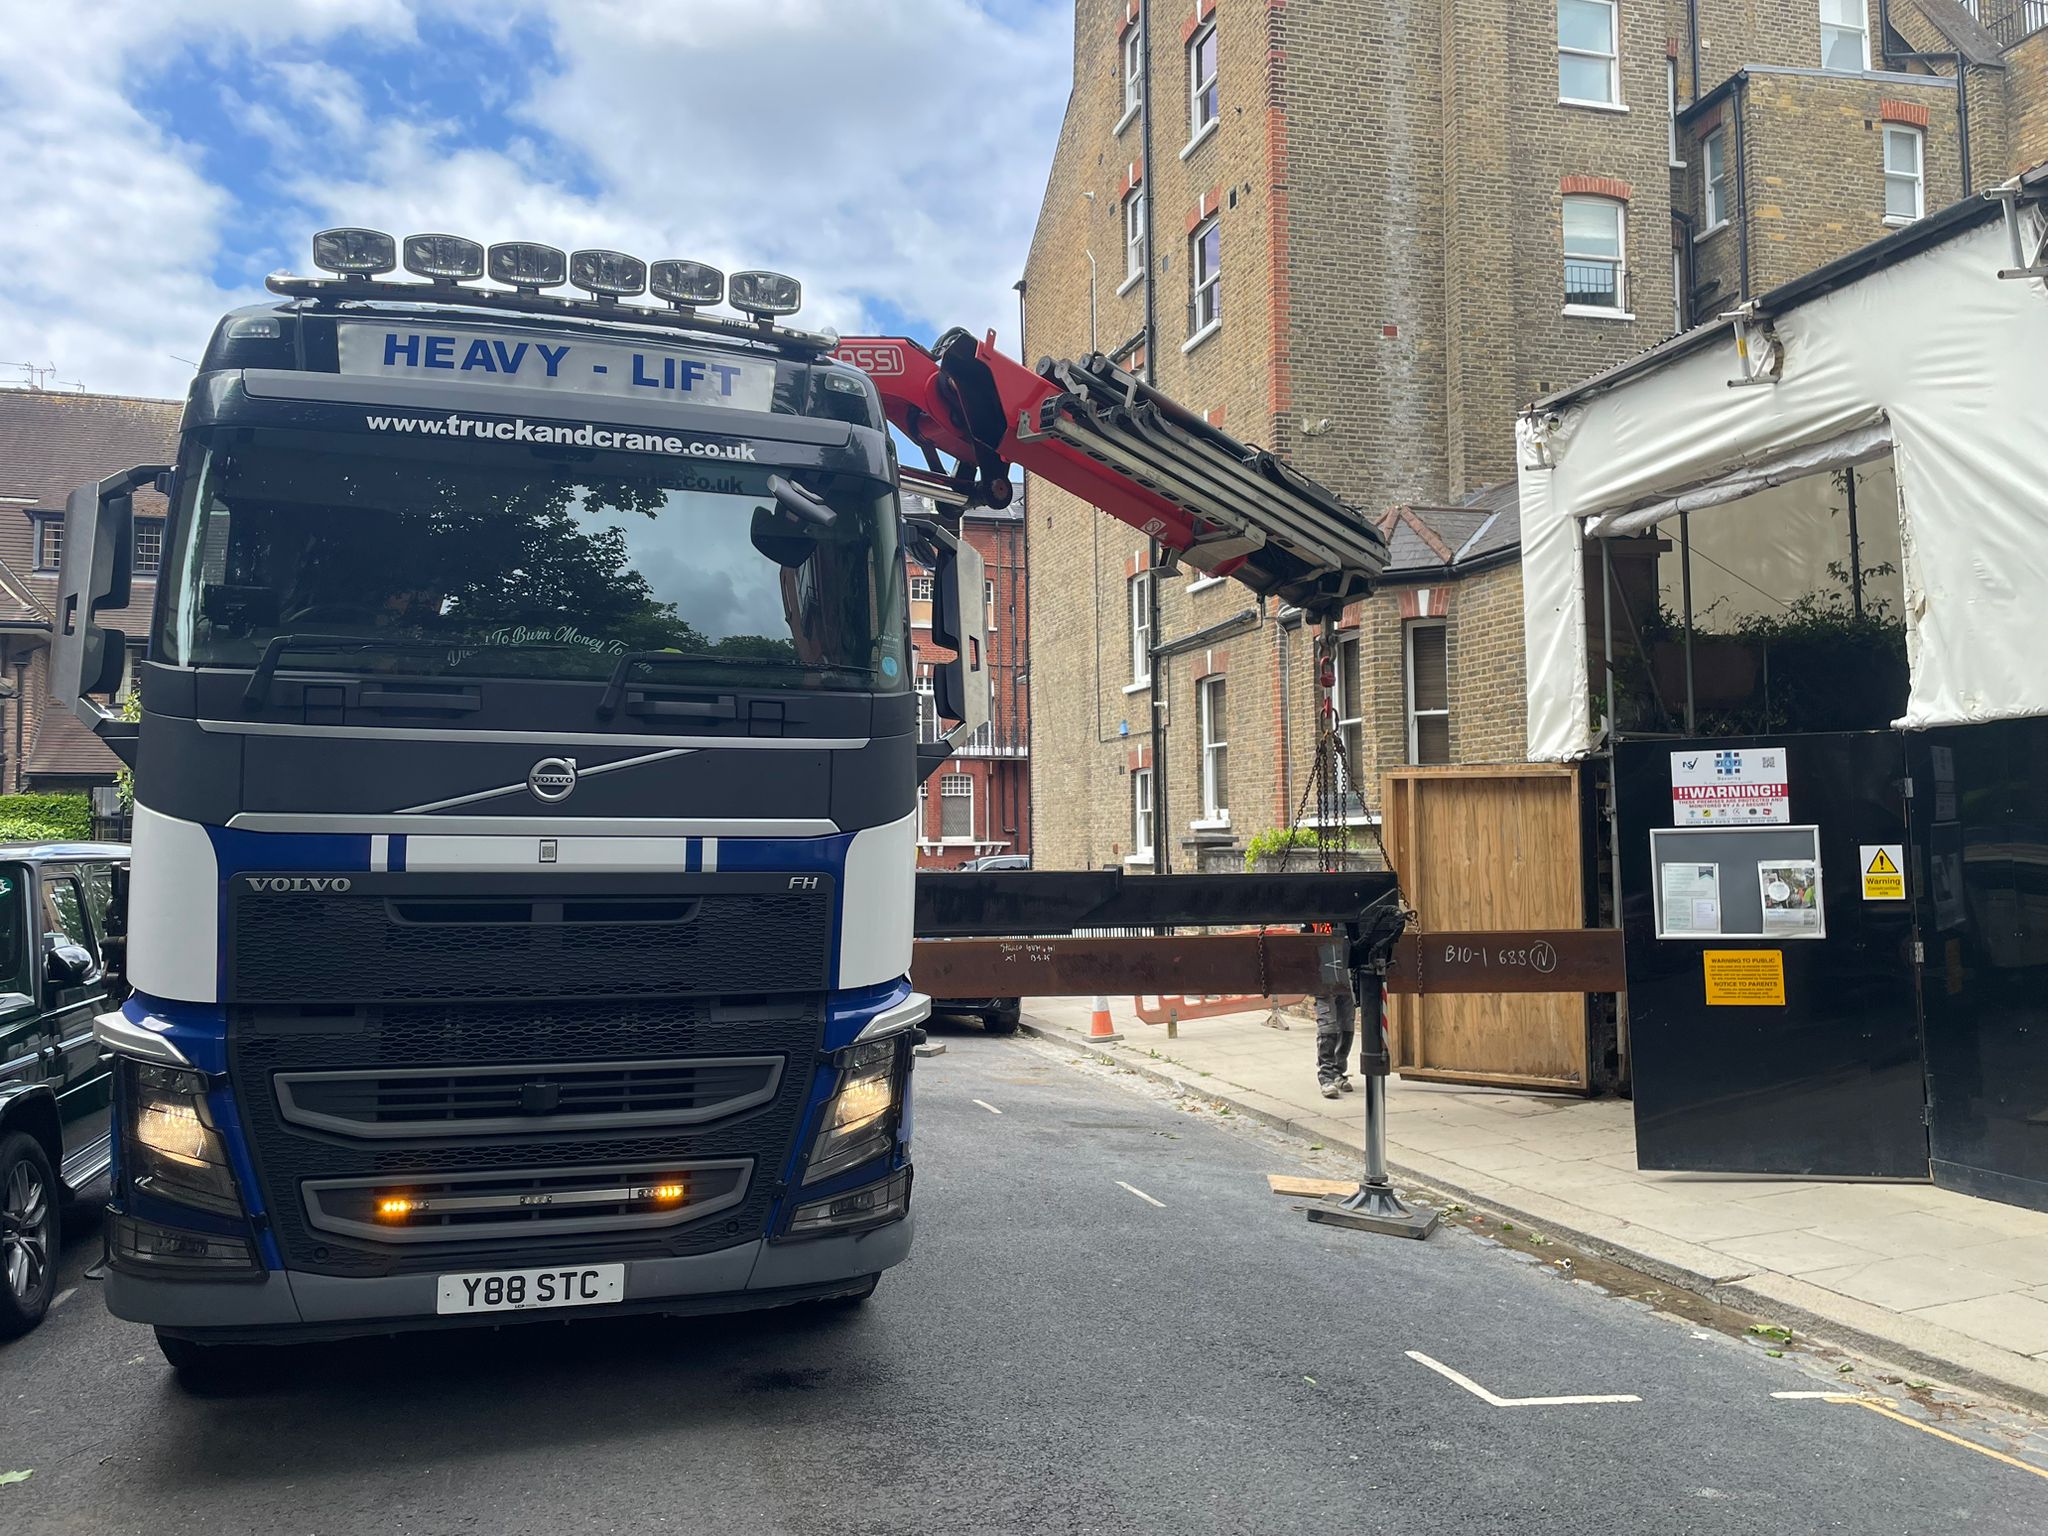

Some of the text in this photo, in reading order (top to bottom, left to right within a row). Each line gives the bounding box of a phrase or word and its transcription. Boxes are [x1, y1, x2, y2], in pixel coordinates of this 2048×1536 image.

[384, 334, 741, 396] HEAVY - LIFT
[827, 349, 899, 371] ASSI
[366, 414, 756, 461] www.truckandcrane.co.uk
[492, 627, 511, 645] To
[512, 626, 552, 645] Burn
[554, 626, 606, 654] Money
[609, 639, 630, 656] To
[531, 776, 573, 784] VOLVO
[1679, 785, 1782, 799] !!WARNING!!
[245, 878, 351, 891] VOLVO
[788, 877, 818, 889] FH
[1866, 878, 1901, 886] Warning
[1445, 945, 1487, 968] B10-1
[1499, 950, 1527, 966] 688
[462, 1271, 598, 1306] Y88 STC
